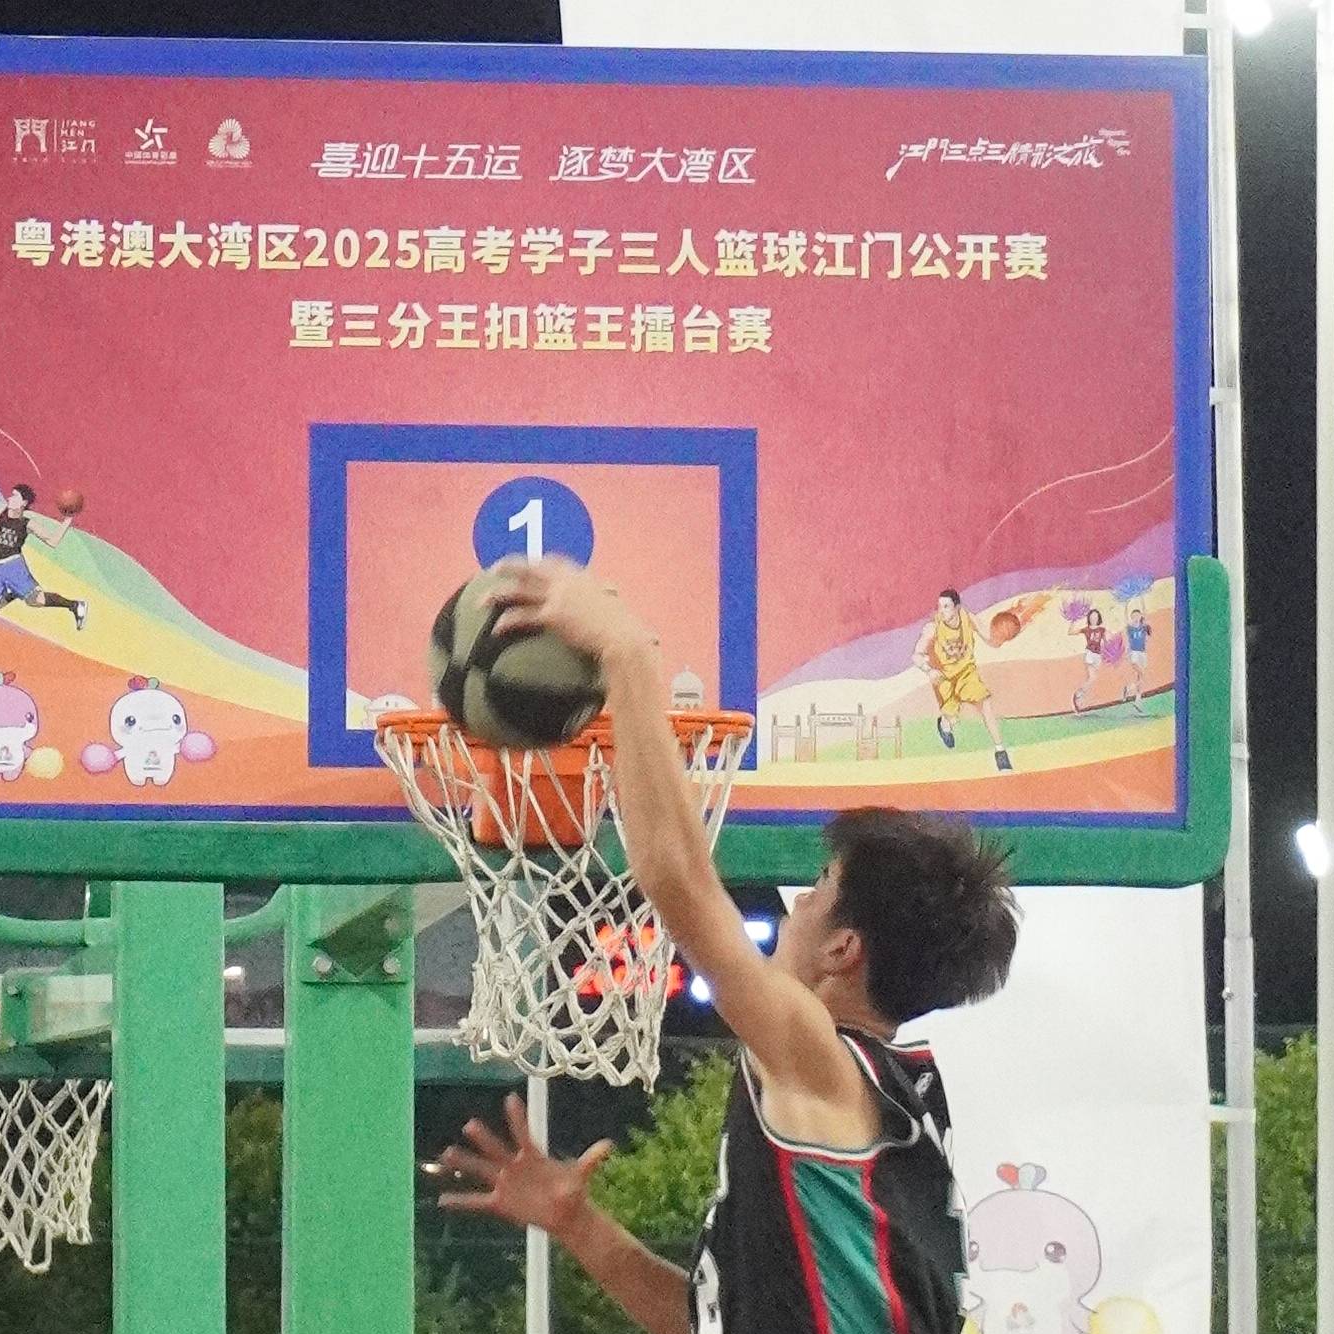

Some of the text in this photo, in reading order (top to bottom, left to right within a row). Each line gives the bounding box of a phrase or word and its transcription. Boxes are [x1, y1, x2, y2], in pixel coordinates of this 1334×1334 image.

[311, 142, 756, 184] 喜迎十五运 逐梦大湾区
[11, 217, 1049, 282] 粤港澳大湾区2025高考学子三人篮球江门公开赛
[288, 300, 773, 355] 暨三分王扣篮王擂台赛
[508, 498, 543, 566] 1
